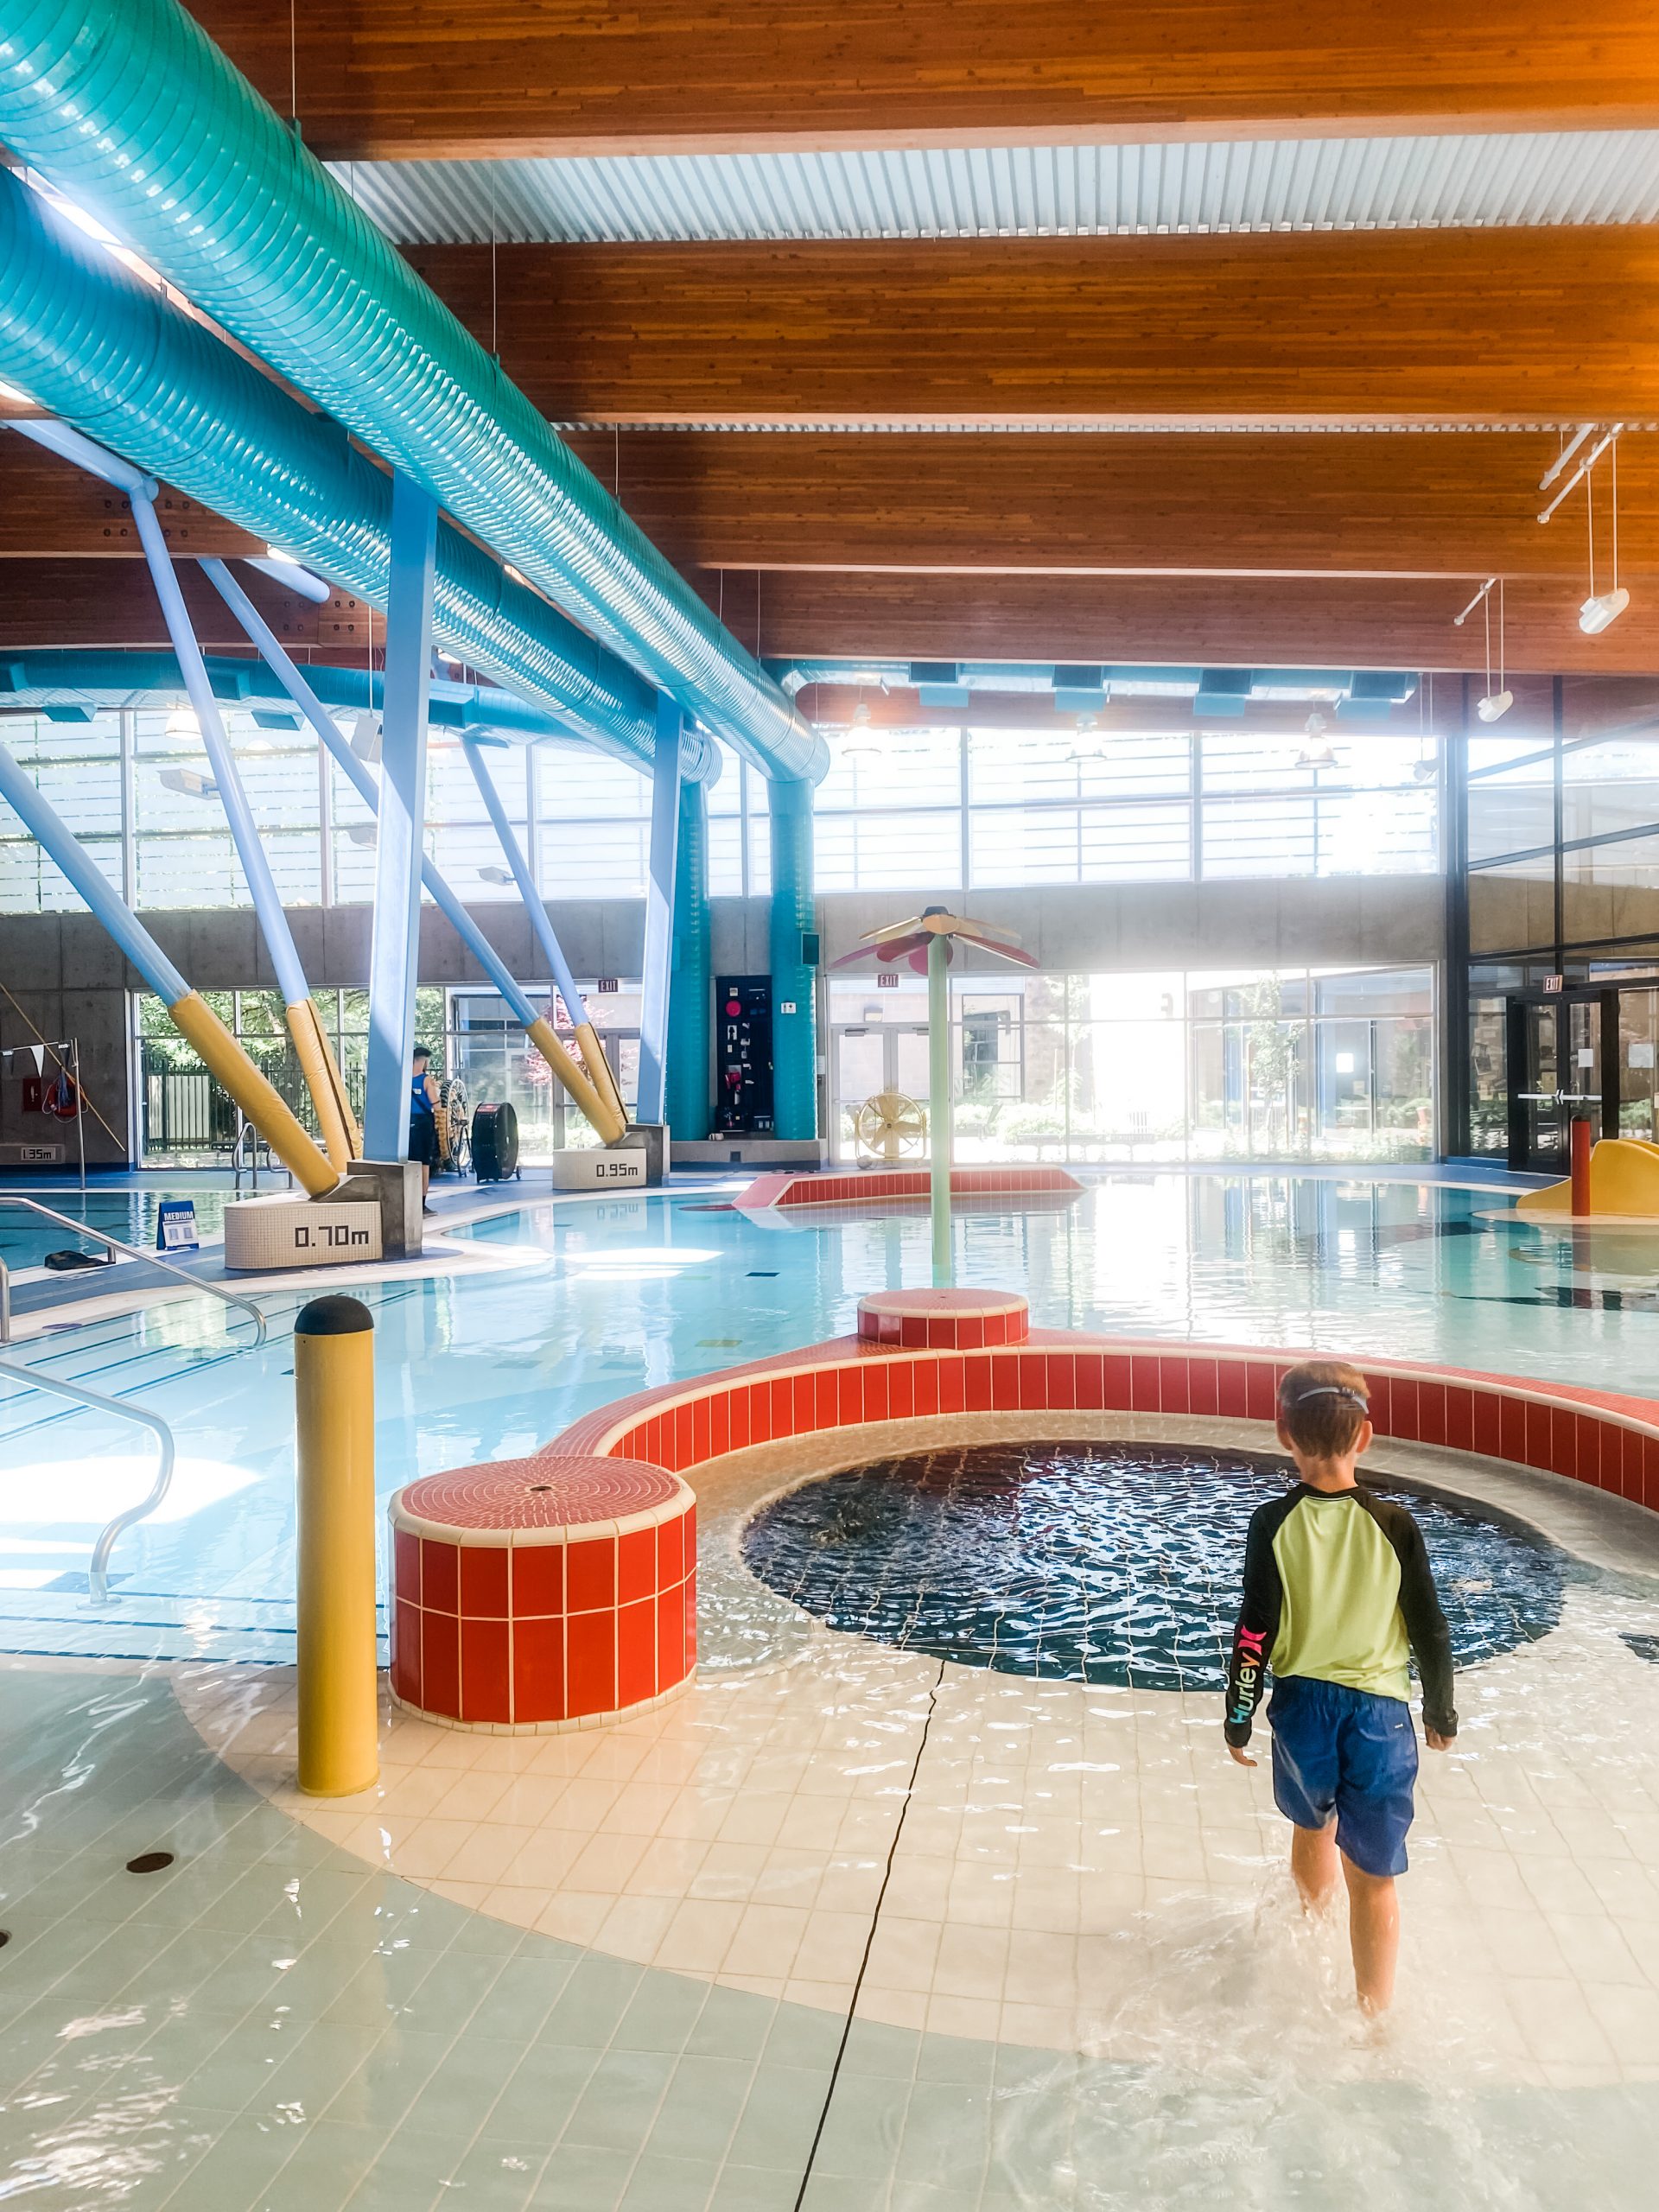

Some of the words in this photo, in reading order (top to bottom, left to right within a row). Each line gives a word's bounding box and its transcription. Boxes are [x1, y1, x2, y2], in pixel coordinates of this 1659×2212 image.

[601, 980, 617, 992] EXIT
[880, 976, 897, 987] EXIT
[1546, 977, 1560, 991] EXIT
[596, 1163, 638, 1177] 0.95m
[164, 1211, 194, 1221] MEDIUM
[295, 1225, 369, 1248] 0.70m
[1230, 1651, 1261, 1724] Hurley
